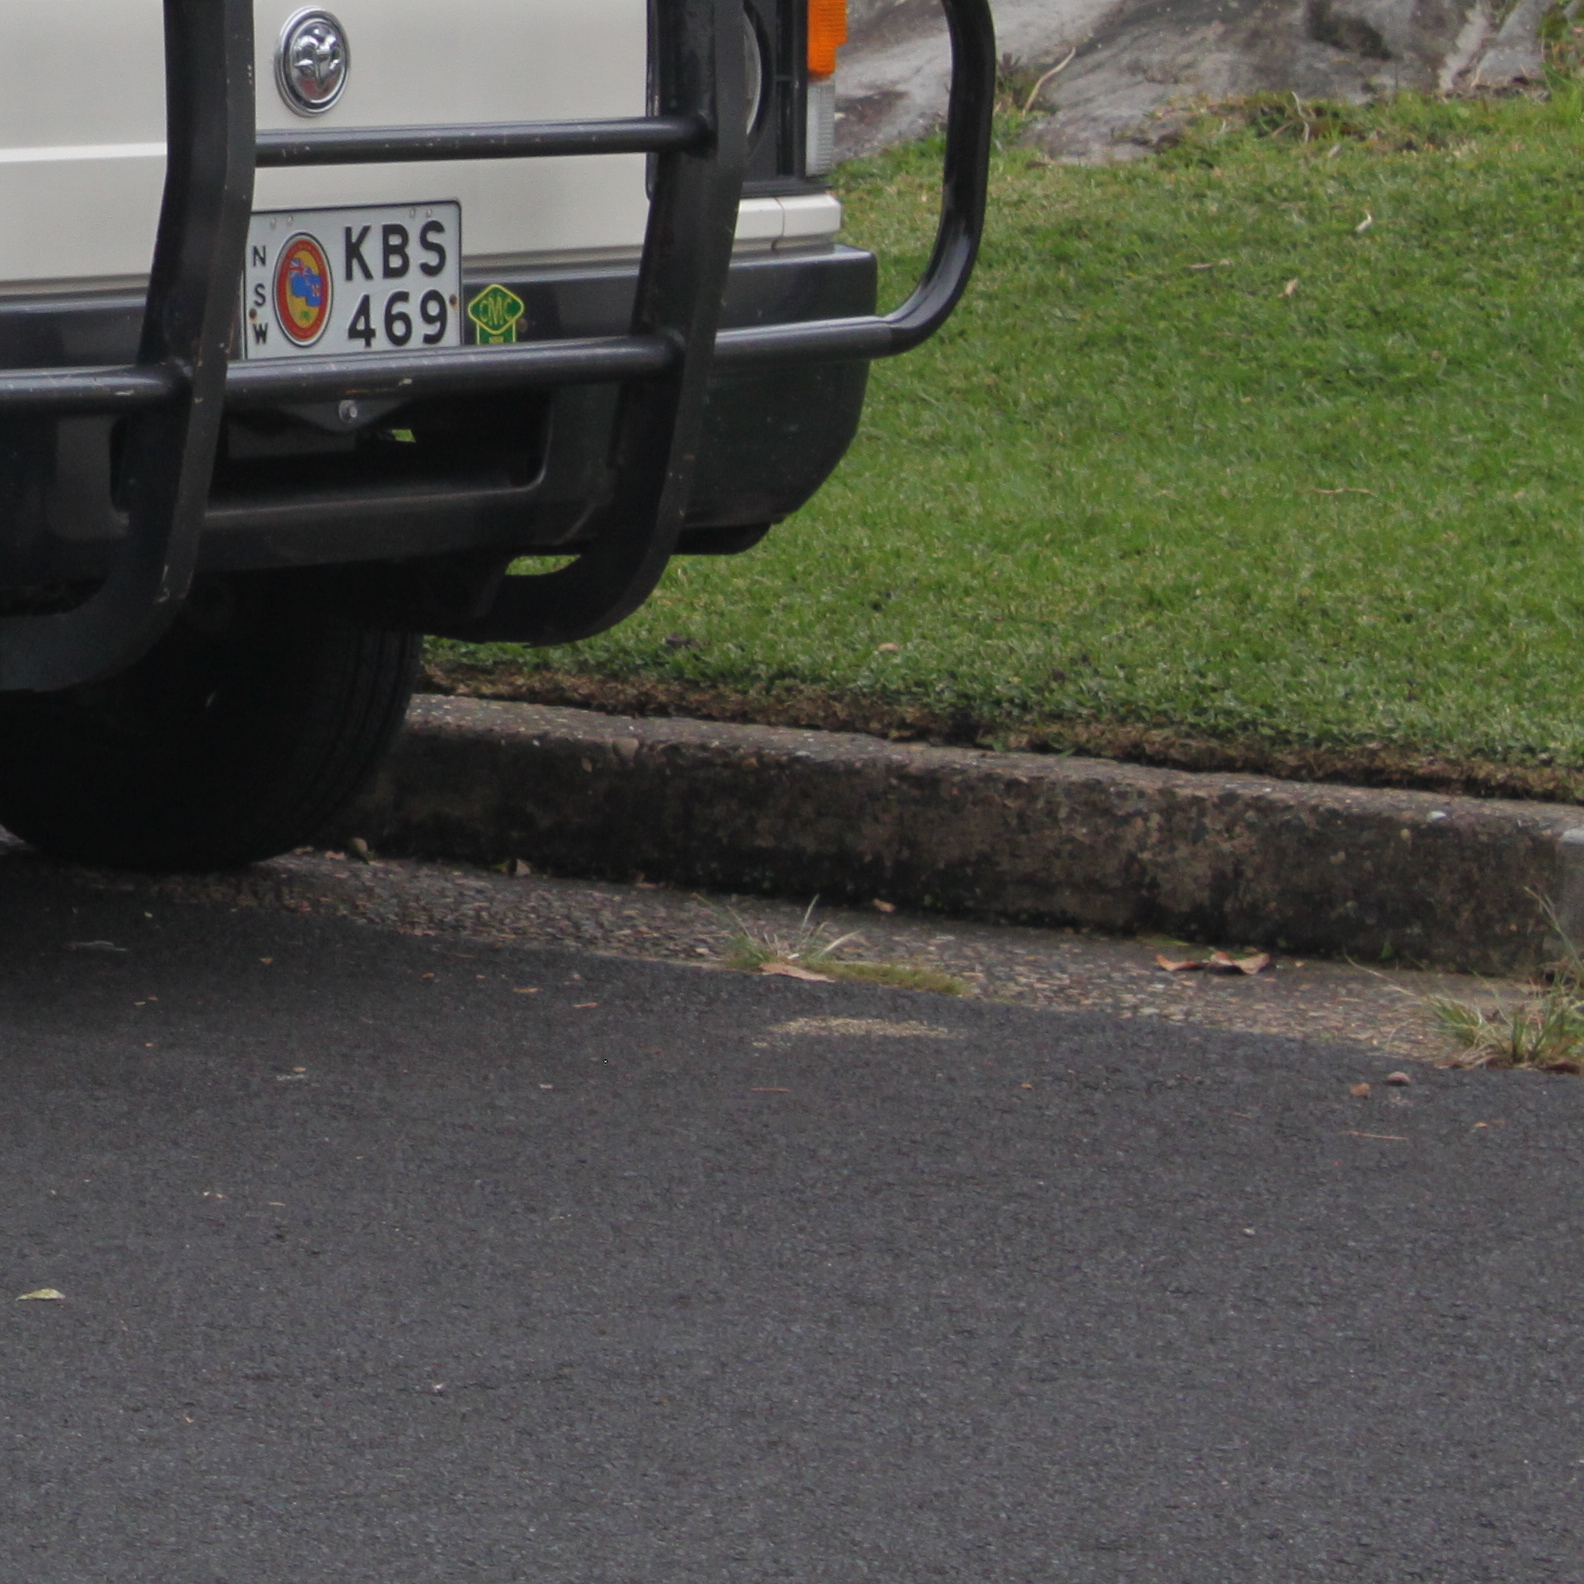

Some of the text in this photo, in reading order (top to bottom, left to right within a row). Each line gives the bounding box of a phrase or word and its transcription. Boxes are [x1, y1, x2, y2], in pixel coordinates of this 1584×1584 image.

[345, 220, 446, 281] KBS
[253, 245, 268, 345] NSW
[348, 289, 448, 348] 469
